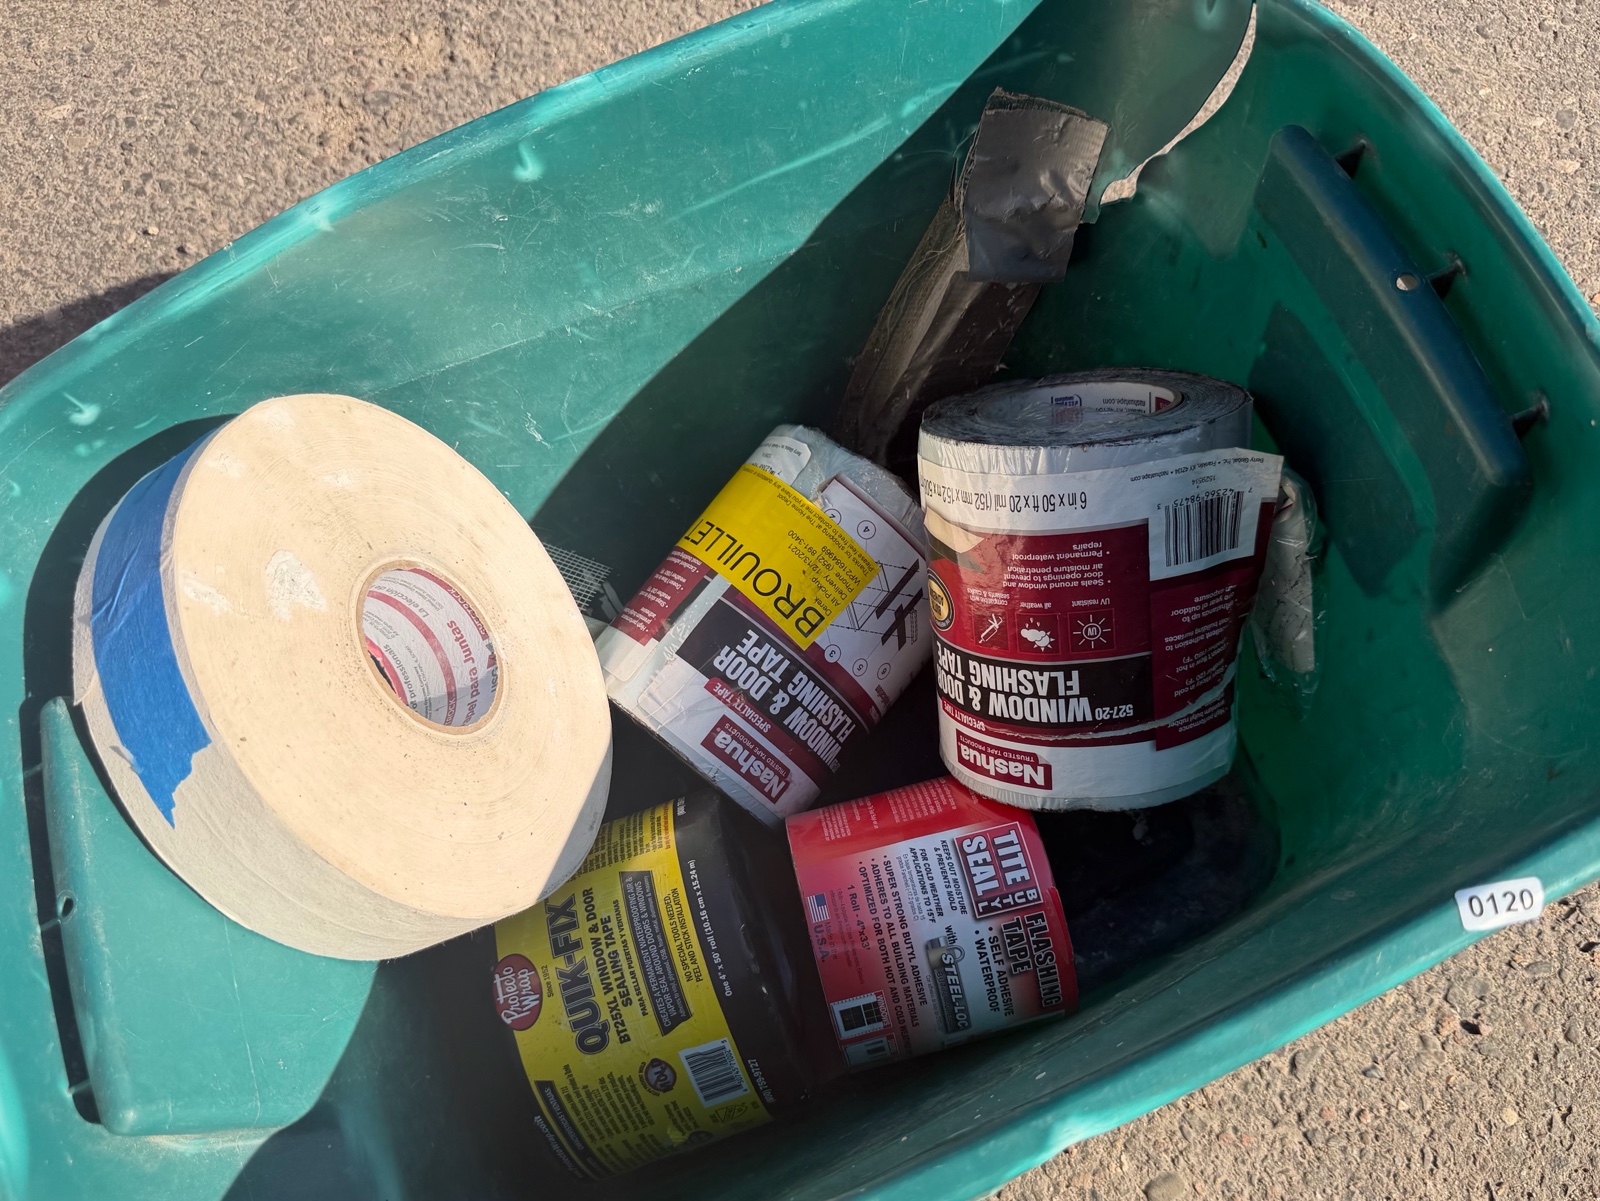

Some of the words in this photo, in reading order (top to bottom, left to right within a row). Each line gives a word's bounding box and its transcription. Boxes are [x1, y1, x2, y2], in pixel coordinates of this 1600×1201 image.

[1102, 398, 1145, 406] nashuatape.com
[1129, 468, 1168, 482] nashuatape.com
[1191, 474, 1215, 484] 1529514
[1009, 495, 1021, 512] 20
[1032, 494, 1038, 512] ft
[1042, 494, 1055, 512] 50
[1067, 492, 1076, 509] in
[1079, 492, 1086, 509] 6
[1173, 493, 1200, 507] 98475
[1204, 487, 1234, 498] 42366
[790, 503, 807, 519] Home
[811, 511, 832, 531] contact
[786, 528, 817, 556] 891-3400
[819, 526, 846, 551] shopping
[862, 525, 870, 534] 4
[787, 542, 821, 574] 12/13/2021
[1056, 549, 1102, 559] Permanent
[1072, 541, 1102, 550] repairs
[815, 552, 835, 572] (952)
[820, 545, 862, 586] WP21684969
[850, 555, 870, 576] Thanks
[1054, 564, 1089, 572] moisture
[682, 518, 826, 637] BROUILLET
[807, 574, 834, 599] Pickup:
[821, 571, 849, 600] Delivery:
[832, 570, 855, 593] Phone:
[1043, 572, 1081, 581] openings
[1049, 580, 1078, 588] around
[1080, 578, 1103, 586] Seals
[418, 607, 429, 618] La
[812, 596, 832, 616] Derek
[830, 596, 841, 607] Alt
[1071, 598, 1098, 606] resistant
[1170, 605, 1200, 616] outdoor
[445, 618, 476, 666] Juntas
[828, 649, 836, 658] 3
[1174, 633, 1204, 648] adhesion
[732, 628, 795, 683] TAPE
[856, 663, 864, 671] 5
[936, 642, 965, 681] TAPE
[383, 643, 418, 698] professionals
[467, 666, 481, 699] para
[709, 644, 775, 701] DOOR
[966, 659, 1081, 697] FLASHING
[712, 682, 735, 702] TAPE
[933, 663, 967, 705] DOOR
[1173, 686, 1188, 696] cold
[763, 688, 792, 716] &
[783, 669, 858, 743] FLASHING
[966, 685, 981, 711] &
[987, 691, 1093, 724] WINDOW
[1094, 703, 1133, 719] 527-20
[724, 722, 754, 749] PRODUCTS
[782, 705, 845, 765] WINDOW
[752, 746, 767, 759] TAPE
[986, 746, 1001, 755] TAPE
[1002, 751, 1034, 762] TRUSTED
[709, 729, 789, 800] Nashua
[765, 756, 787, 776] TRUSTED
[957, 743, 1047, 785] Nashua
[919, 847, 928, 861] FOR
[961, 834, 1000, 896] SEAL
[992, 829, 1030, 885] TITE
[870, 862, 887, 904] ADHERES
[923, 861, 934, 881] COLD
[935, 852, 951, 889] PREVENTS
[946, 890, 957, 911] MOLD
[939, 839, 952, 860] KEEPS
[946, 861, 956, 876] OUT
[951, 876, 967, 915] MOISTURE
[626, 882, 634, 893] AIR
[634, 880, 647, 912] WINDOWS
[857, 865, 877, 915] OPTIMIZED
[928, 881, 943, 917] WEATHER
[977, 887, 1038, 913] BUTYL
[580, 887, 596, 921] DOOR
[611, 899, 625, 932] VENTANAS
[662, 893, 675, 920] NEEDED,
[670, 887, 688, 929] INSTALLATION
[882, 906, 891, 920] TO
[1468, 888, 1533, 917] 0120
[586, 922, 599, 934] &
[598, 914, 617, 948] TAPE
[627, 893, 647, 949] WATERPROOFING
[641, 918, 655, 944] DOORS
[669, 920, 681, 942] TOOLS
[871, 916, 882, 936] FOR
[882, 859, 897, 889] SUPER
[891, 890, 907, 929] STRONG
[901, 931, 916, 962] BUTYL
[910, 963, 927, 1006] ADHESIVE
[886, 920, 896, 939] ALL
[944, 924, 957, 944] with
[681, 929, 693, 949] STICK
[707, 935, 717, 949] roll
[812, 924, 831, 963] U.S.A.
[876, 937, 889, 964] BOTH
[986, 934, 1004, 967] SELF
[999, 915, 1033, 975] TAPE
[589, 935, 615, 994] WINDOW
[620, 938, 635, 969] PUERTAS
[648, 943, 664, 975] AROUND
[675, 941, 690, 970] SPECIAL
[687, 949, 698, 965] AND
[890, 940, 908, 984] BUILDING
[1023, 910, 1064, 1007] FLASHING
[540, 964, 550, 980] 1952
[542, 891, 609, 1055] QUIK-FIX
[607, 949, 633, 1007] SEALING
[628, 969, 642, 996] SELLAR
[640, 948, 659, 991] PERMANENT
[683, 970, 693, 981] NO
[692, 964, 703, 982] PEEL
[883, 965, 895, 984] HOT
[973, 938, 1001, 1013] WATERPROOF
[492, 965, 531, 1024] Protecto
[517, 967, 539, 1011] Wrap
[544, 980, 554, 997] Since
[657, 974, 669, 993] SEAL
[720, 980, 733, 996] One
[888, 985, 899, 1003] AND
[940, 952, 969, 1028] STEEL-LOC
[994, 968, 1015, 1016] ADHESIVE
[636, 996, 649, 1016] PARA
[654, 996, 671, 1027] CREATES
[663, 992, 677, 1016] VAPOR
[876, 994, 890, 1026] WINDOWS
[902, 985, 919, 1027] MATERIALS
[605, 995, 631, 1043] BT25XL
[747, 1057, 768, 1089] 759-9727
